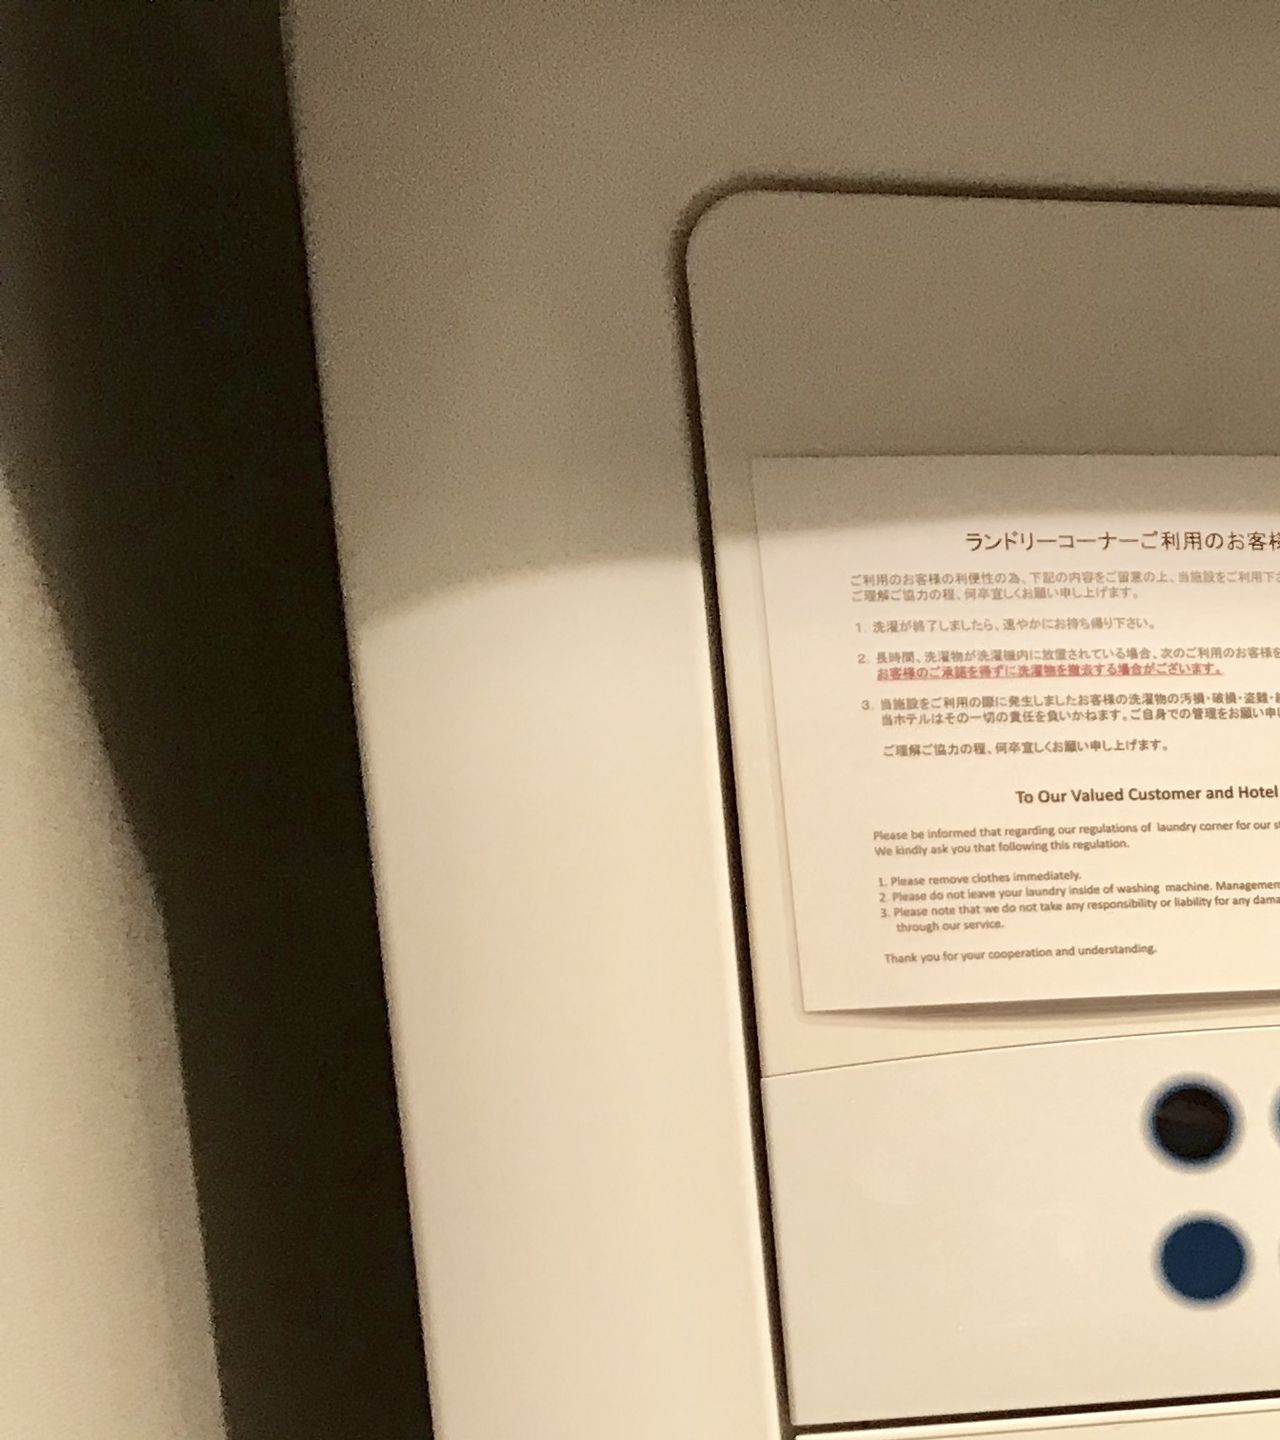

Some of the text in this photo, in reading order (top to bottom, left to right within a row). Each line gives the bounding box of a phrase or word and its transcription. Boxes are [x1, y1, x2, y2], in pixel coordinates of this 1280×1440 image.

[1014, 790, 1035, 805] To
[1037, 789, 1068, 804] Our
[1069, 787, 1125, 803] Valued
[1127, 787, 1203, 802] Customer
[1205, 785, 1235, 800] and
[1237, 784, 1279, 799] Hotel
[872, 830, 909, 841] Please
[910, 829, 925, 840] be
[927, 827, 977, 839] informed
[978, 826, 1003, 838] that
[1004, 825, 1056, 839] regarding
[1057, 826, 1077, 835] our
[1078, 823, 1139, 837] regulations
[1140, 821, 1152, 833] of
[1156, 821, 1197, 833] laundry
[1198, 822, 1235, 832] corner
[1235, 819, 1252, 831] for
[1252, 821, 1272, 831] our
[874, 838, 1130, 857] We kindly ask you that following this regulation.
[890, 876, 926, 887] Please
[928, 875, 970, 886] remove
[970, 872, 1011, 884] clothes
[1012, 870, 1082, 882] immediately.
[891, 891, 928, 902] Please
[929, 890, 945, 901] do
[946, 890, 966, 900] not
[967, 888, 997, 900] leave
[997, 889, 1023, 900] your
[1025, 885, 1067, 898] laundry
[1068, 884, 1101, 896] inside
[1102, 883, 1115, 895] of
[1115, 882, 1161, 896] washing
[1164, 881, 1213, 893] machine.
[893, 906, 929, 918] Please
[930, 906, 956, 916] note
[957, 904, 981, 915] that
[982, 905, 1000, 914] we
[1001, 902, 1017, 914] do
[1018, 903, 1038, 913] not
[1039, 901, 1063, 912] take
[1065, 902, 1086, 913] any
[1086, 897, 1158, 912] responsibility
[1159, 899, 1172, 908] or
[1173, 896, 1213, 909] liability
[1213, 895, 1230, 907] for
[1231, 896, 1251, 908] any
[895, 919, 1005, 934] through our service.
[884, 943, 1158, 964] Thank you for your cooperation and understanding.
